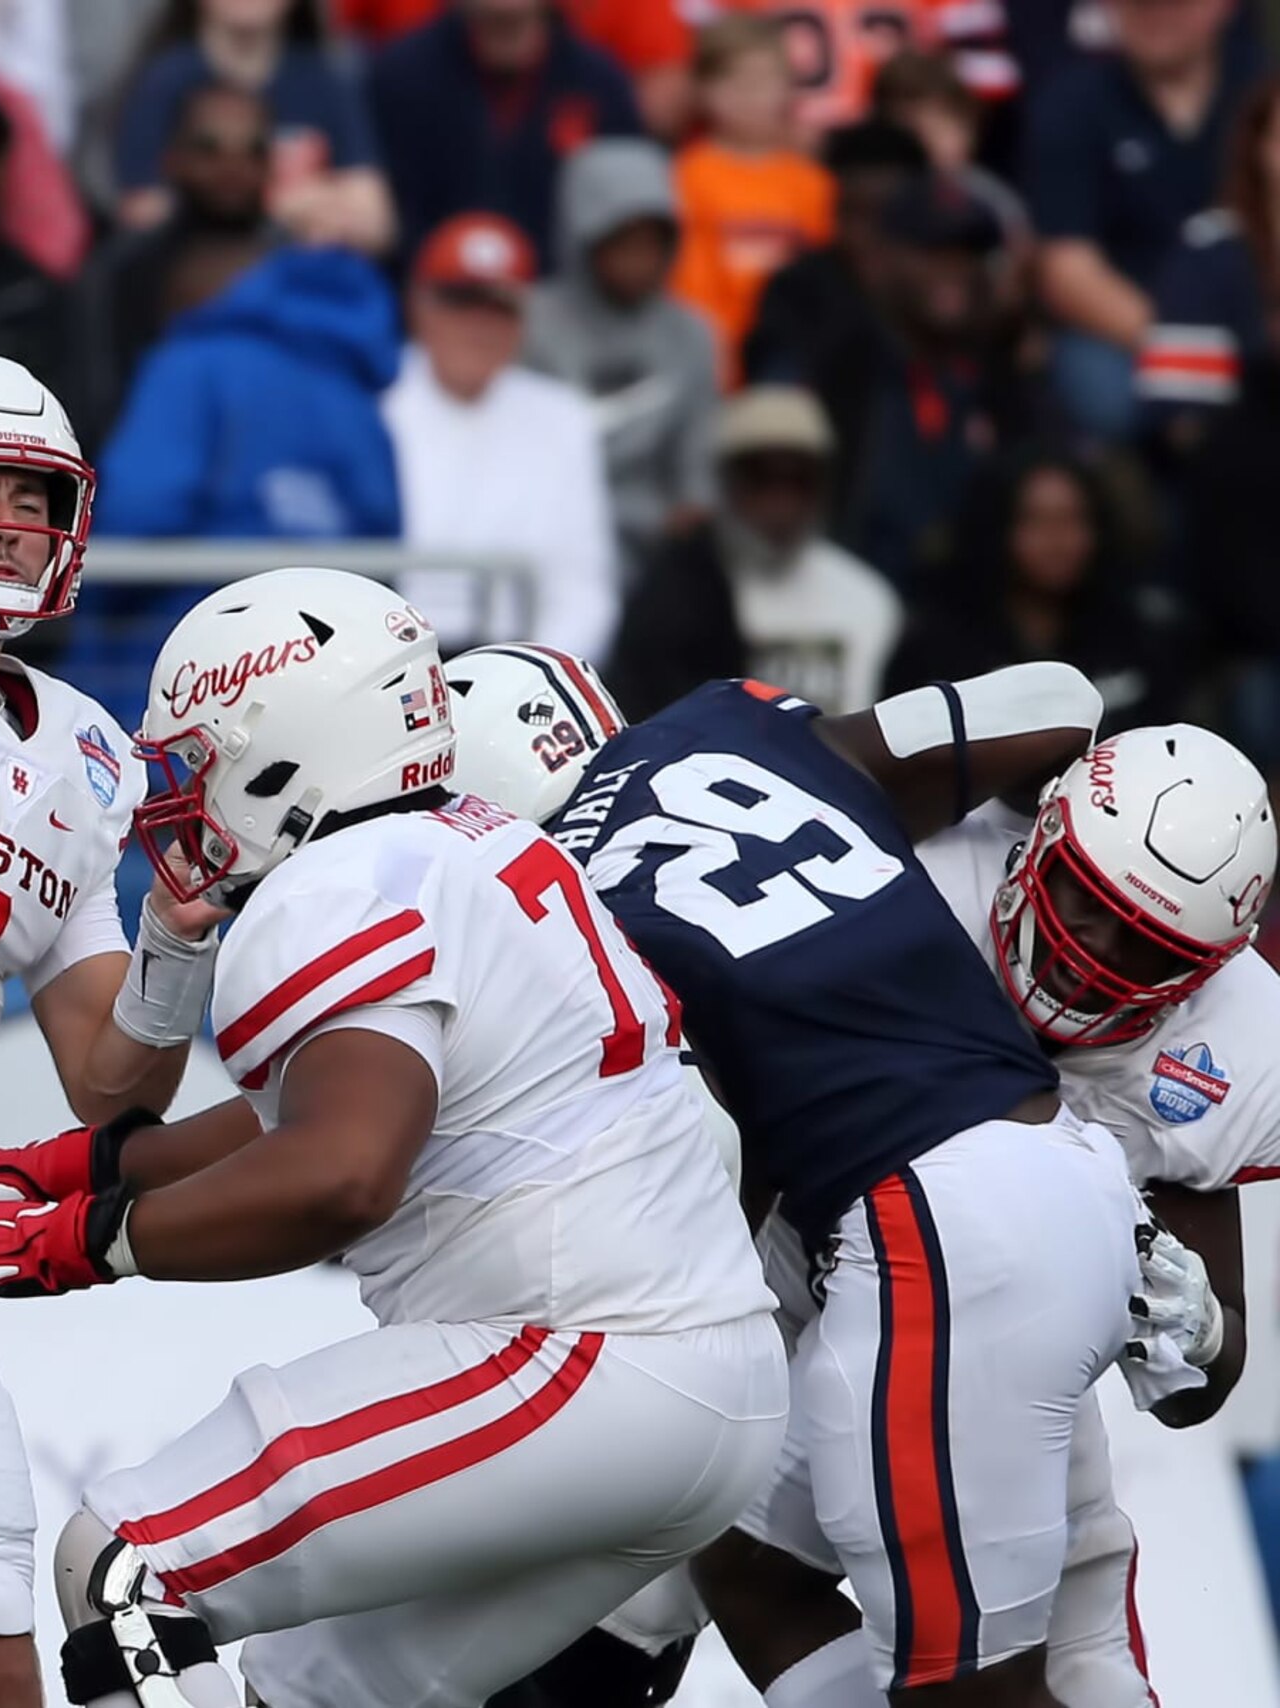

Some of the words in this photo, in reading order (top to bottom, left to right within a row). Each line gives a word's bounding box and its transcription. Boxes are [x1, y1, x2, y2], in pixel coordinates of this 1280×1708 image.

[171, 635, 316, 719] Cougars
[531, 720, 586, 774] 29
[553, 759, 650, 850] HALL
[586, 752, 905, 960] 29
[1124, 871, 1183, 917] HOUSTON
[495, 838, 683, 1079] 7
[1157, 1090, 1198, 1117] BOWL
